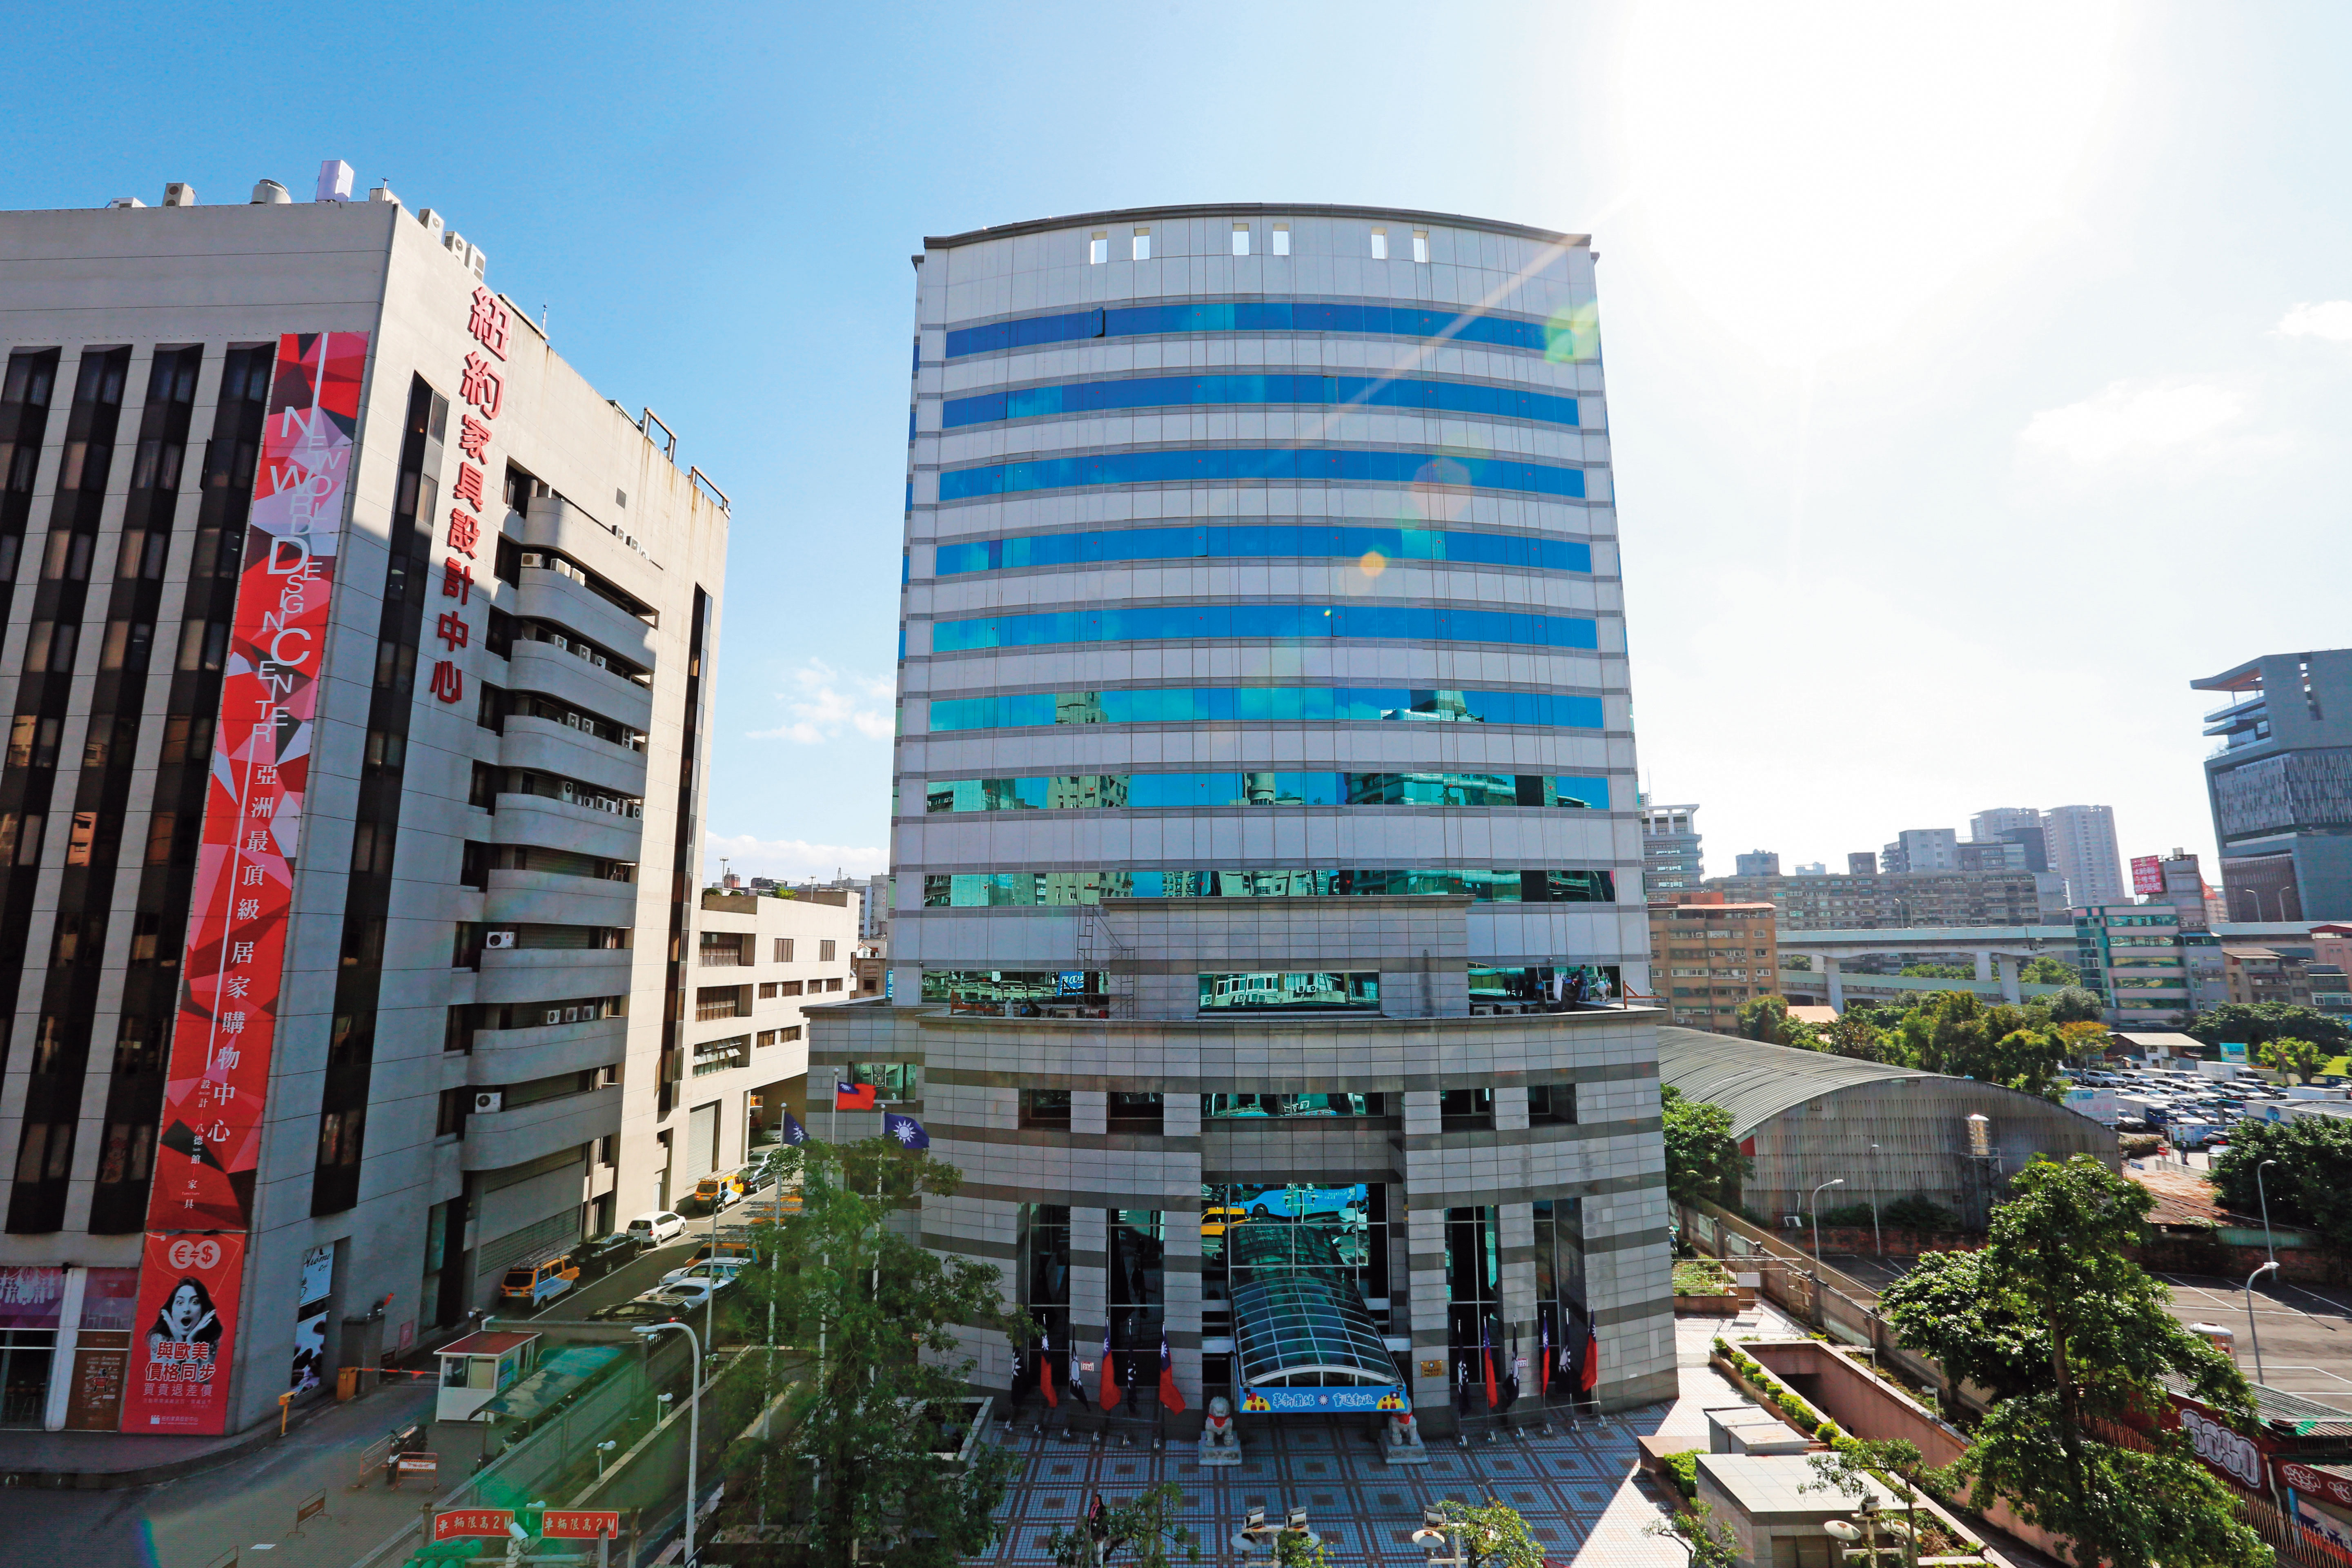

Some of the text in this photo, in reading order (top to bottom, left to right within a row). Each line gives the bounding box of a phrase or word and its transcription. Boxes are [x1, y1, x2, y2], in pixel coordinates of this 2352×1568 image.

[270, 465, 332, 536] WORLD
[430, 286, 511, 704] 紐約家具設計中心
[262, 537, 323, 632] DESIGN
[251, 628, 312, 743] CENTER
[207, 764, 279, 1142] 亞洲最頂級居家購物中心
[184, 1079, 210, 1209] 設計 八德館 家具
[143, 1383, 213, 1396] 買貴退差價
[145, 1361, 216, 1382] 價格同步
[156, 1341, 209, 1361] 與歐美
[1272, 1392, 1375, 1407] 革新團結 重返執政
